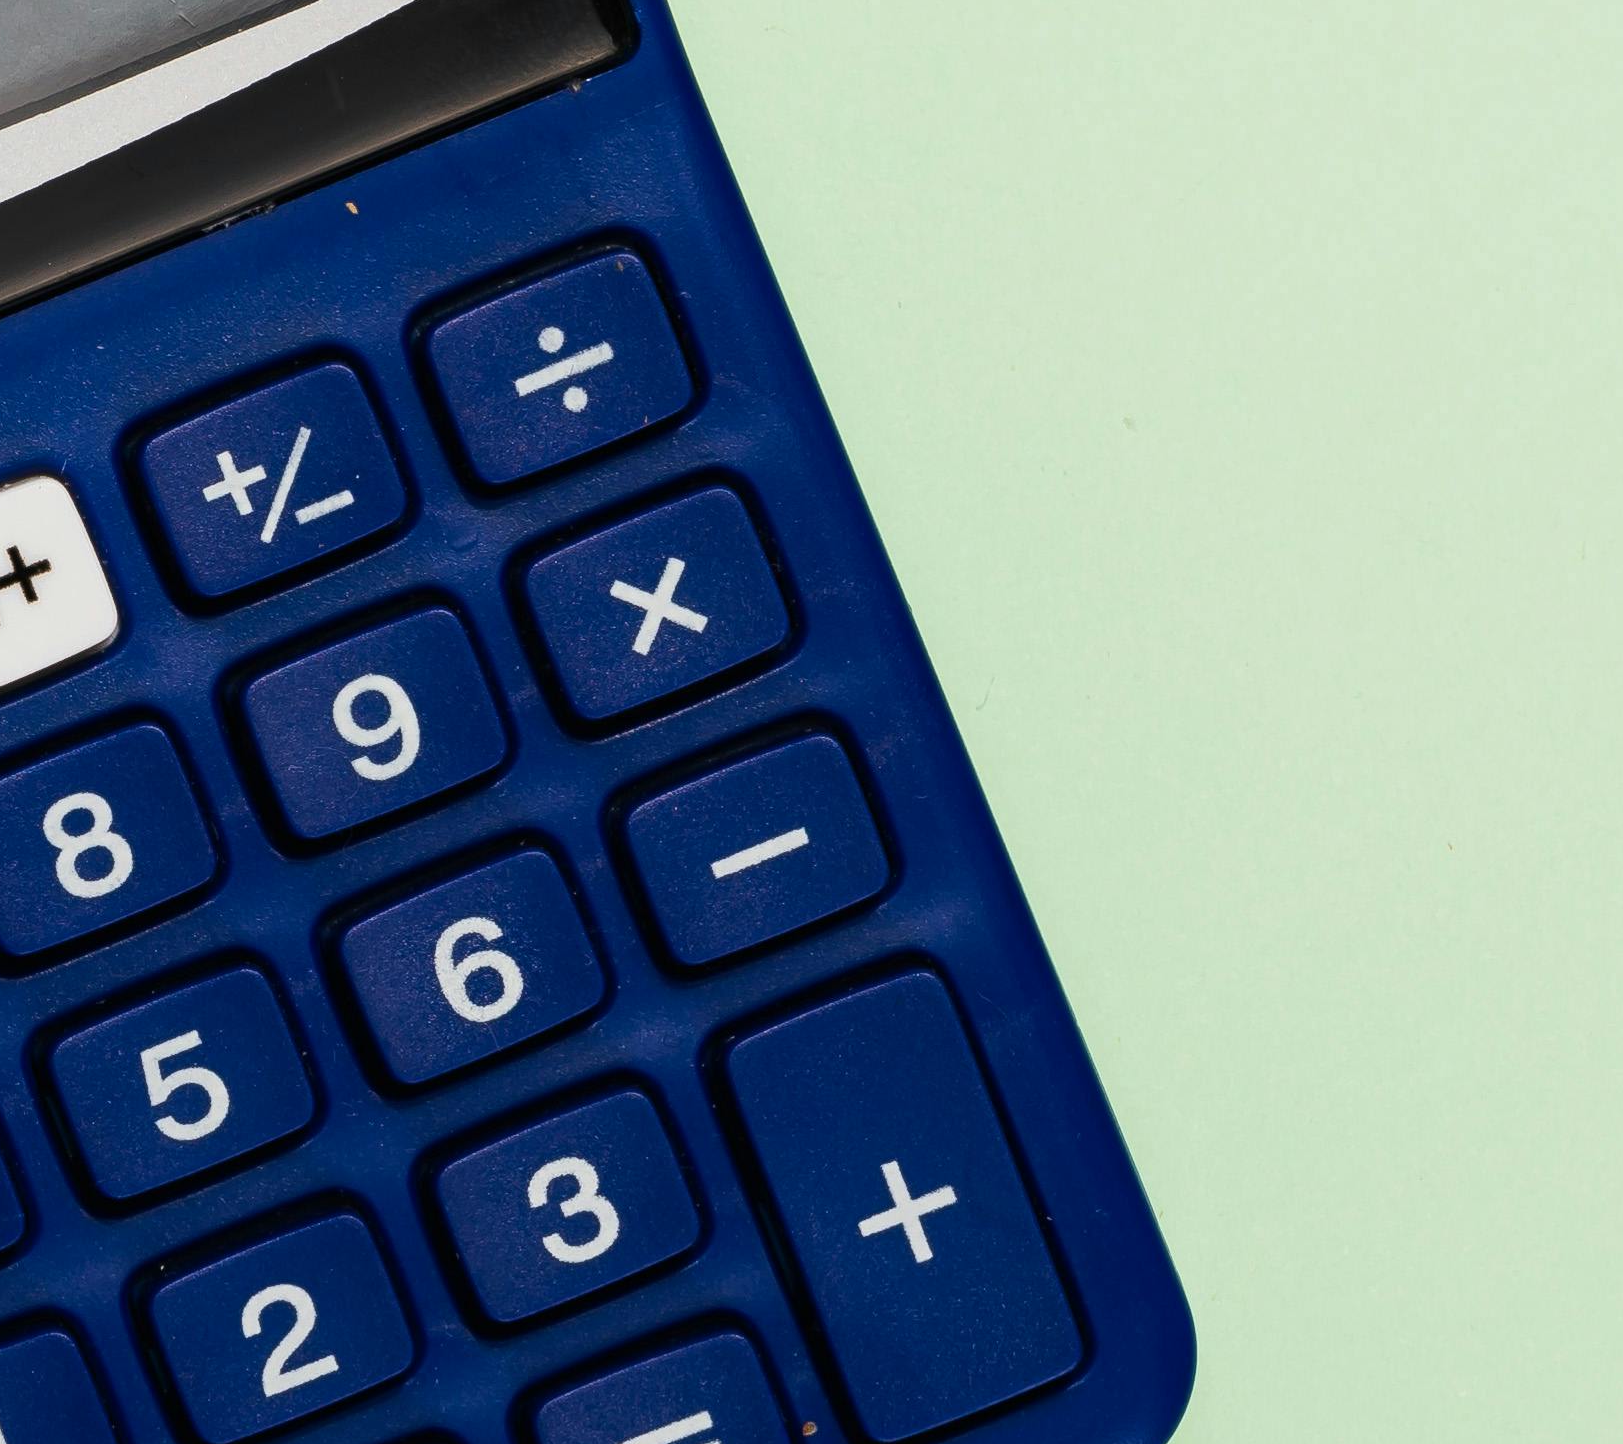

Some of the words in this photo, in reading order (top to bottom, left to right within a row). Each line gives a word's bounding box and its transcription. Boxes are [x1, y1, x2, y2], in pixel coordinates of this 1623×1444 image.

[333, 673, 420, 780] 9
[43, 792, 133, 898] 8
[434, 917, 523, 1022] 6
[141, 1030, 230, 1140] 5
[528, 1157, 619, 1263] 3
[858, 1161, 957, 1262] +
[242, 1284, 338, 1397] 2
